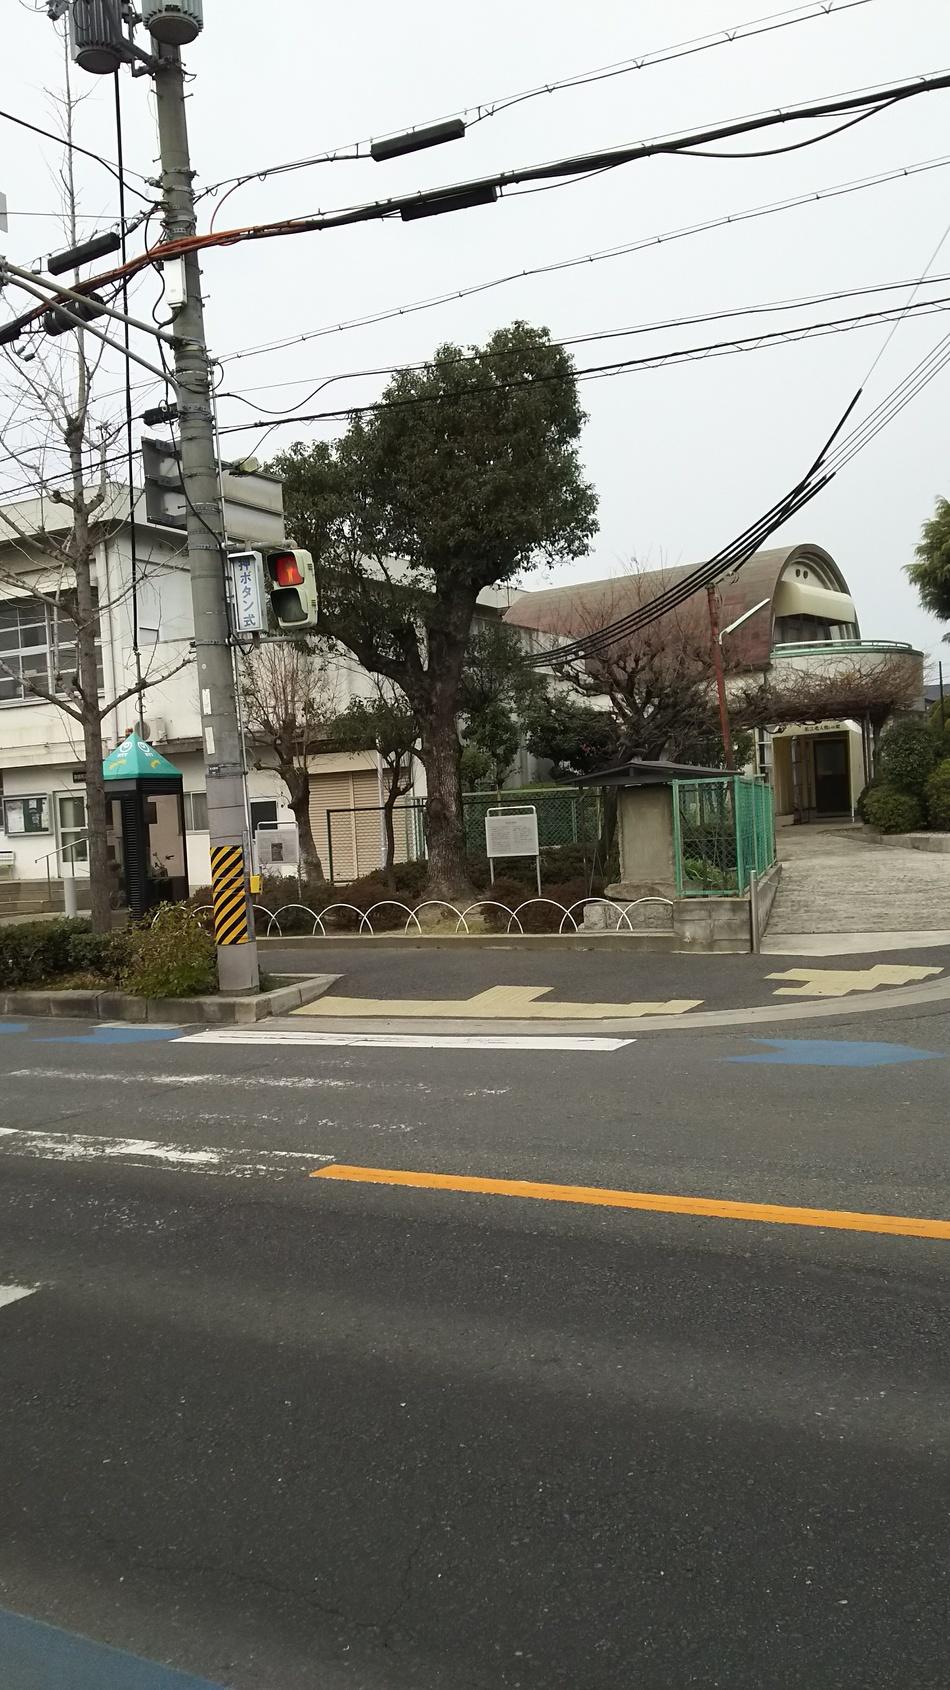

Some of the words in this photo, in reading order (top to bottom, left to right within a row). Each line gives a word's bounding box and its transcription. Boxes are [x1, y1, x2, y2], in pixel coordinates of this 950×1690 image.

[238, 559, 256, 627] 押ボタン式
